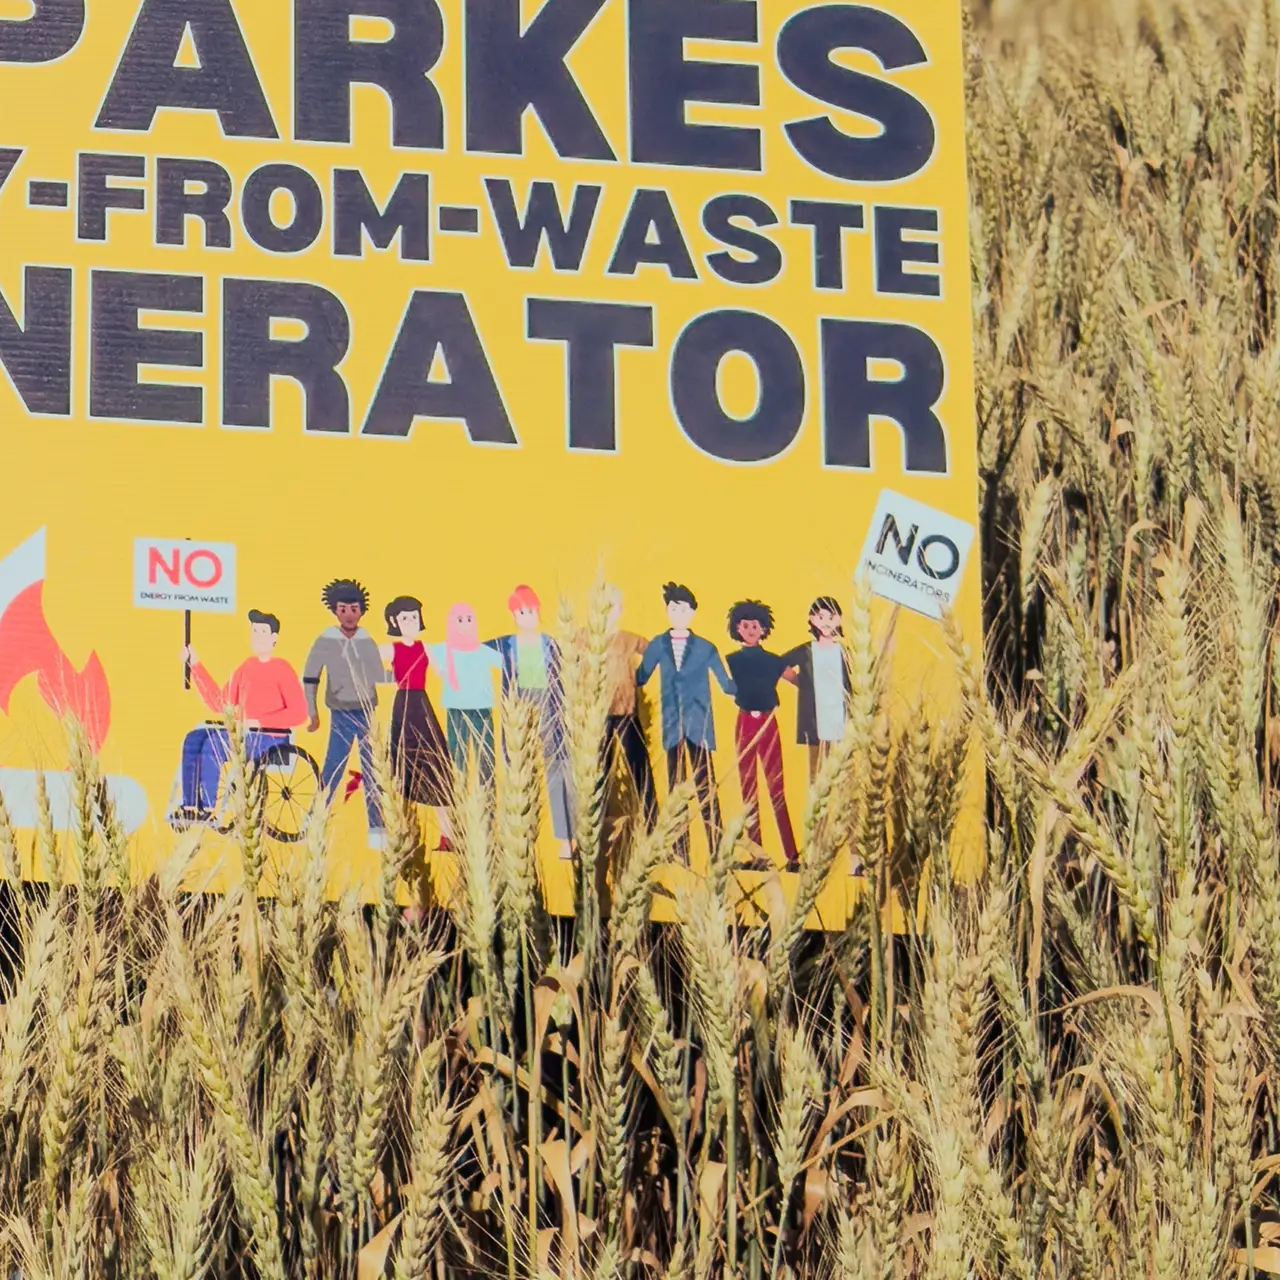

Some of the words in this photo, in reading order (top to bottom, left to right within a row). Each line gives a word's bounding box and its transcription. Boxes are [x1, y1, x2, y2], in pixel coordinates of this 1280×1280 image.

[148, 546, 223, 589] NO
[874, 513, 960, 581] NO
[140, 591, 172, 601] ENERGY
[174, 593, 199, 603] FROM
[201, 596, 229, 605] WASTE
[864, 557, 951, 604] INCINERATORS
